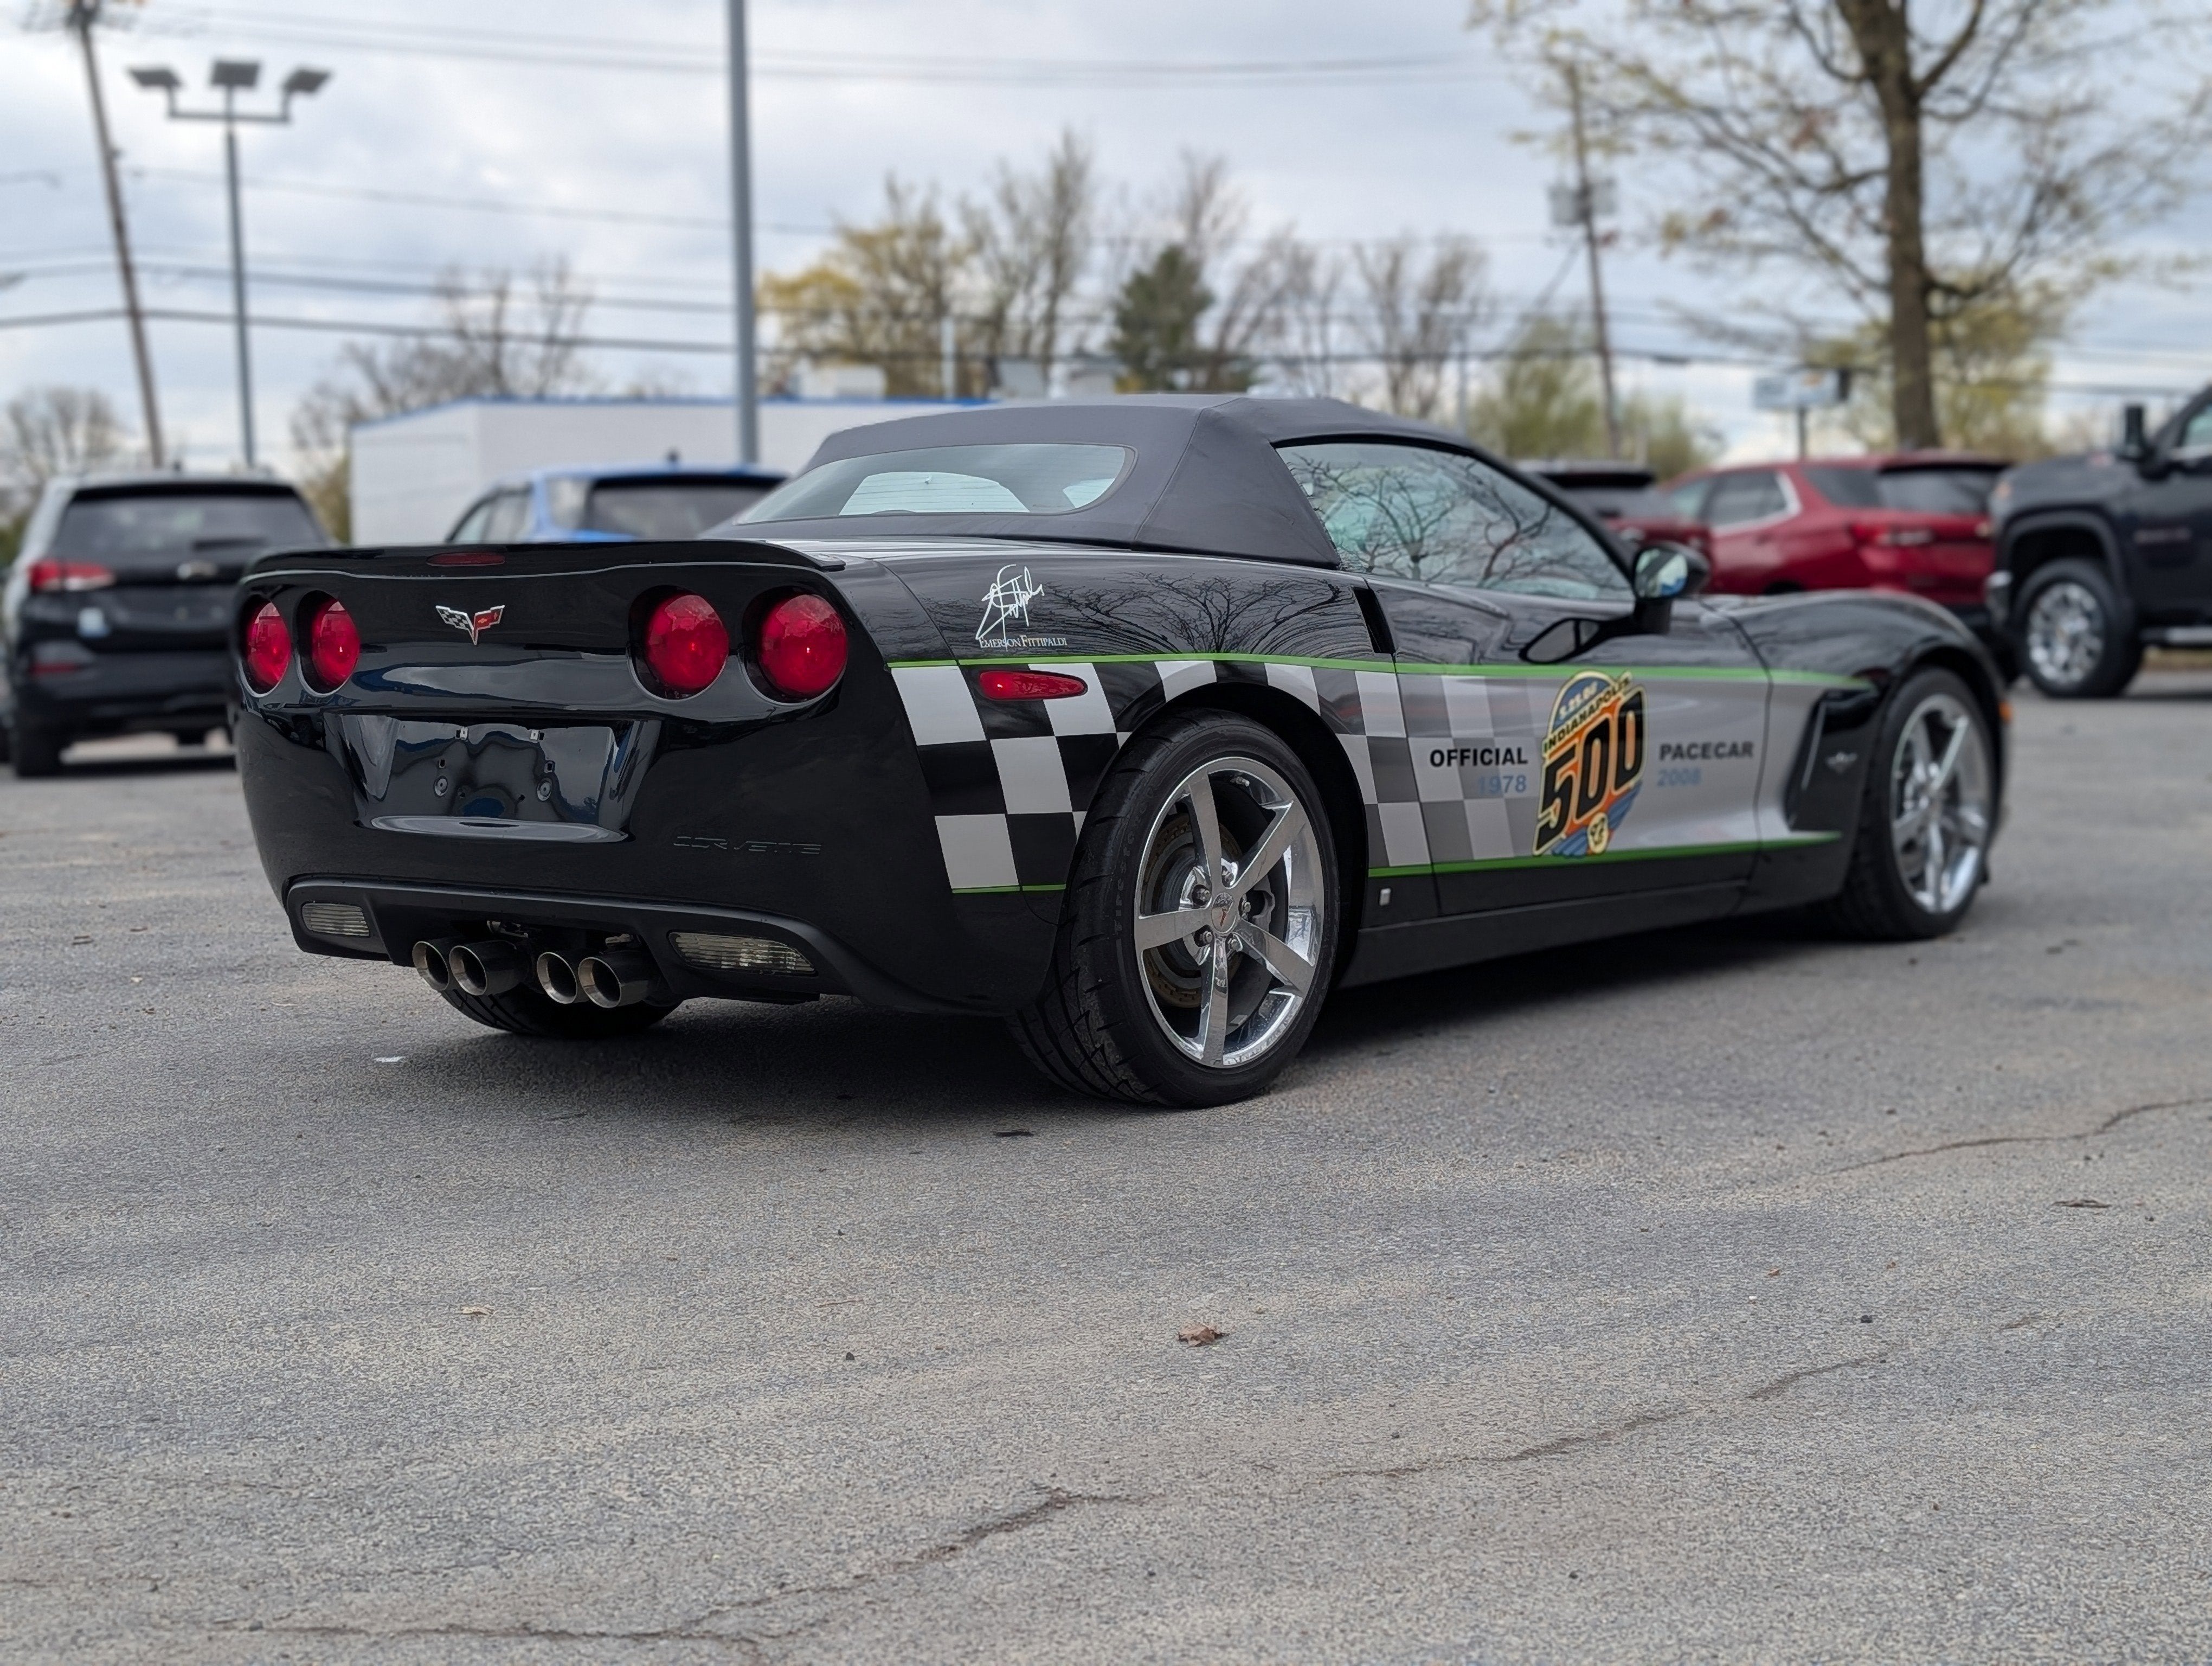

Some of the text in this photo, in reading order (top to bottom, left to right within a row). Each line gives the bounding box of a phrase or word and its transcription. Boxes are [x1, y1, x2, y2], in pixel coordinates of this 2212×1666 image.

[1544, 677, 1629, 753] INDIANAPOLIS
[1430, 746, 1529, 768] OFFICIAL
[1659, 741, 1754, 760] PACECAR
[1535, 690, 1644, 851] 500
[1478, 773, 1527, 793] 1978
